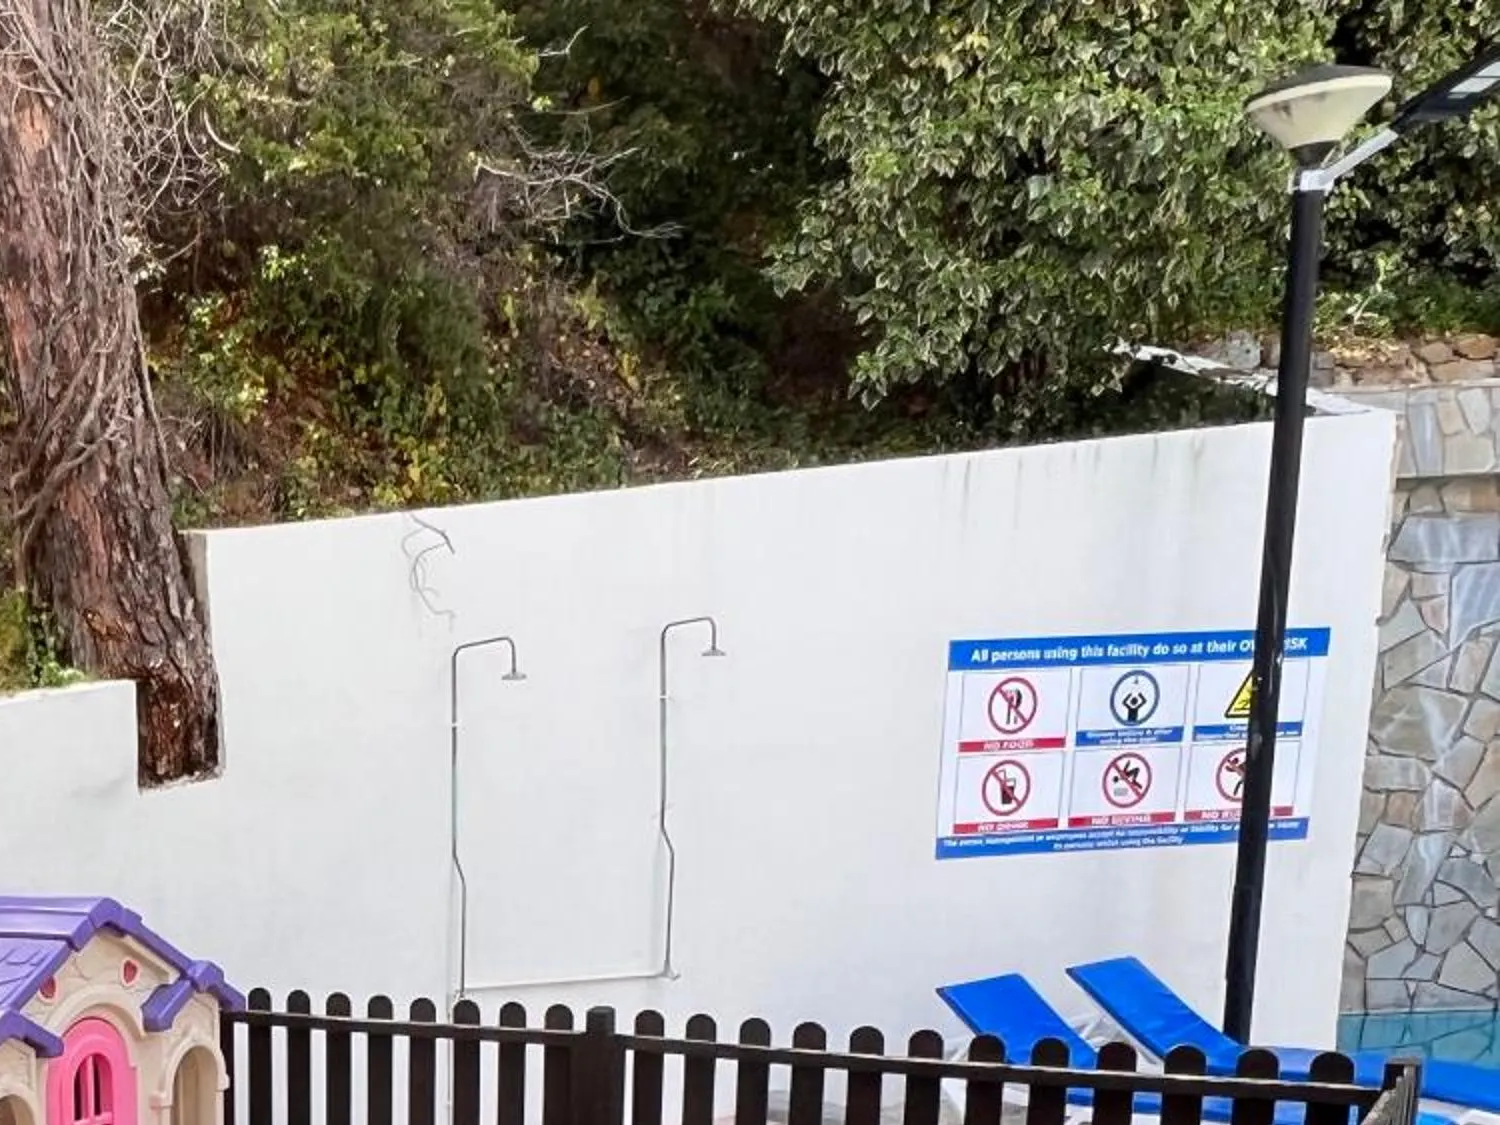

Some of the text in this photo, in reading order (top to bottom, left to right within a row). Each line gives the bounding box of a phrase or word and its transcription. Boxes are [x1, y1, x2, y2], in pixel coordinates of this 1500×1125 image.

[971, 649, 988, 662] All
[991, 649, 1040, 664] persons
[1044, 647, 1078, 660] using
[1081, 644, 1104, 657] this
[1107, 642, 1150, 658] facility
[1153, 641, 1169, 655] do
[1172, 643, 1187, 655] so
[1190, 642, 1204, 654] at
[1207, 639, 1238, 653] their
